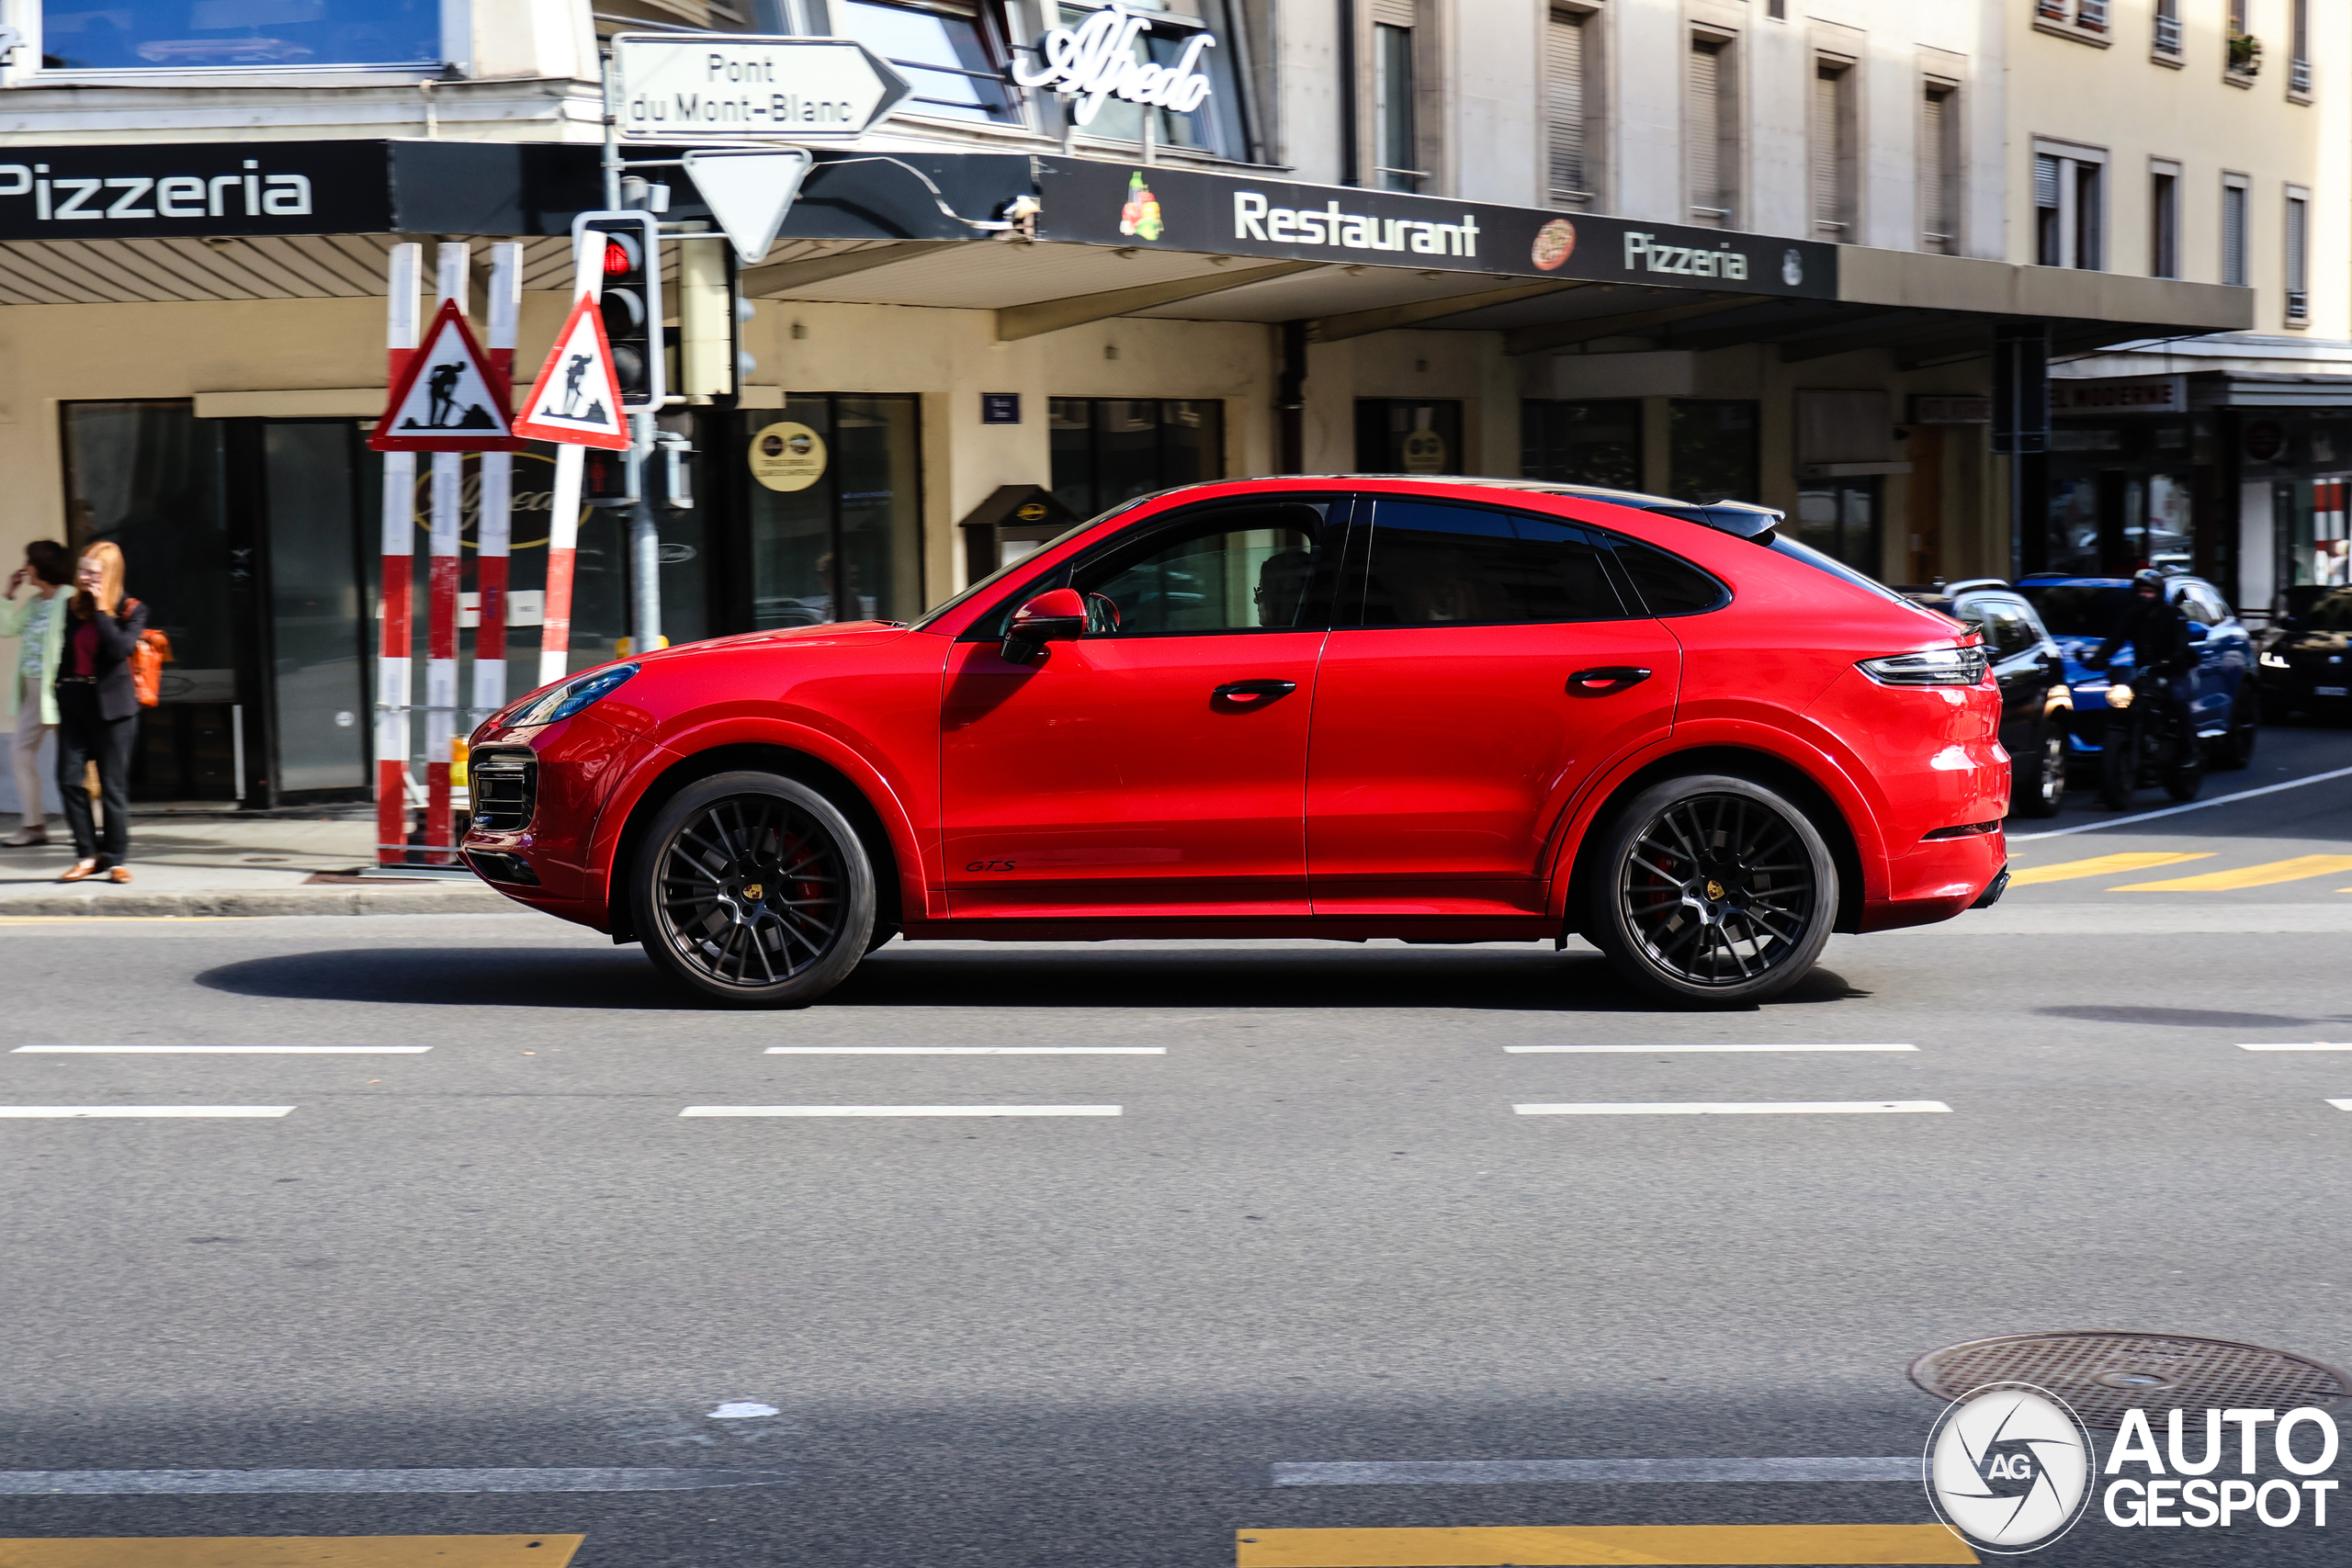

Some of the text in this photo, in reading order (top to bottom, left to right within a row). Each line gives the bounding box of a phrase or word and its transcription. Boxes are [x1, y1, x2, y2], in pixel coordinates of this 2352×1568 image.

[707, 53, 775, 83] Pont
[1012, 4, 1216, 126] Alfredo
[630, 93, 853, 121] du Mont-Blanc
[1234, 191, 1480, 256] Restaurant
[1623, 231, 1747, 280] Pizzeria
[966, 861, 1016, 872] GTS
